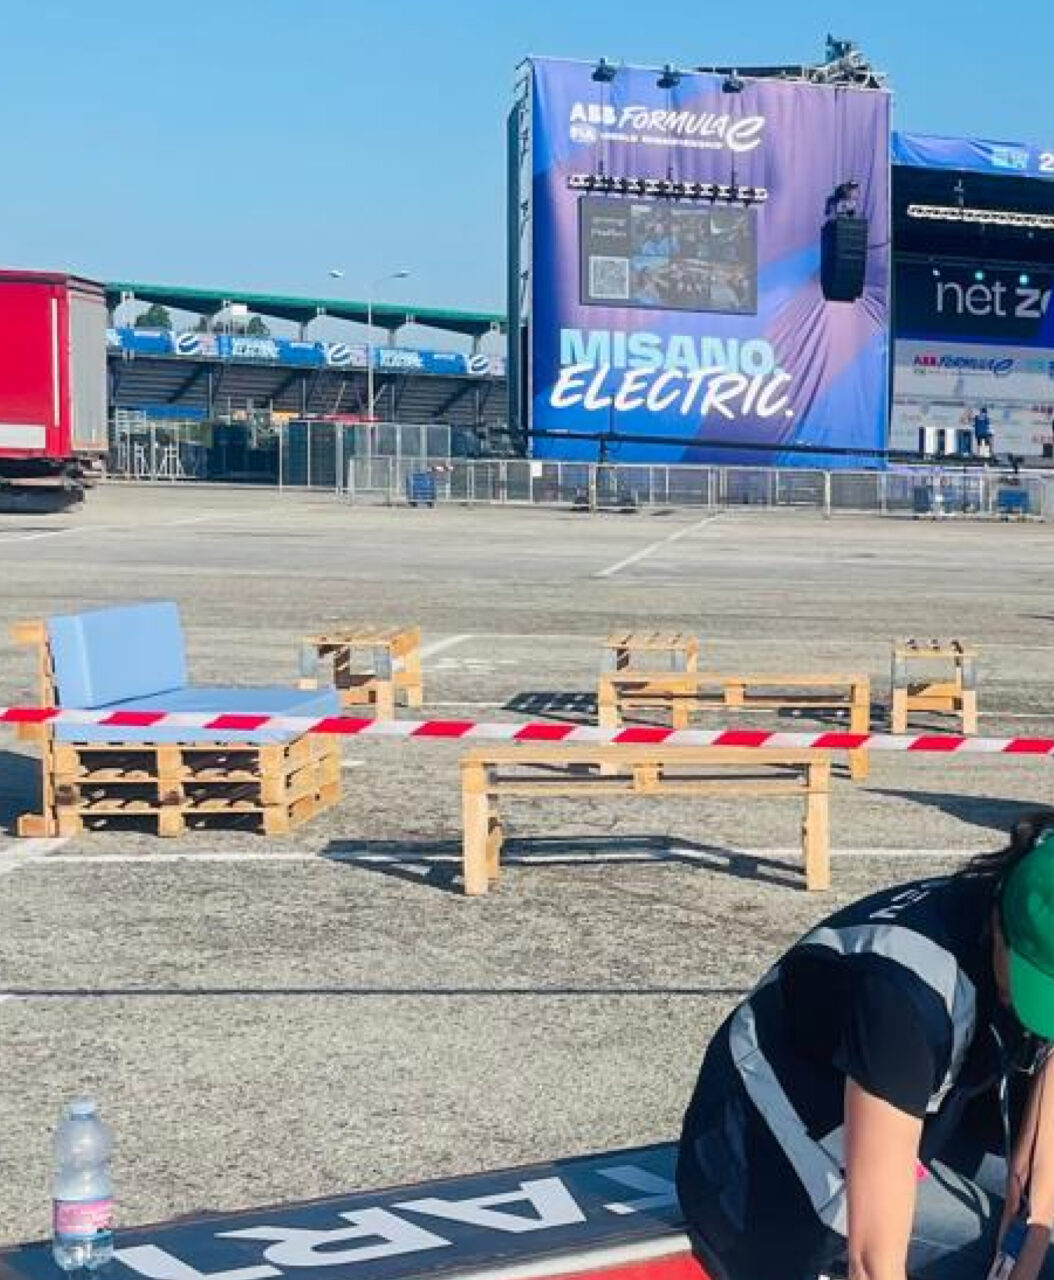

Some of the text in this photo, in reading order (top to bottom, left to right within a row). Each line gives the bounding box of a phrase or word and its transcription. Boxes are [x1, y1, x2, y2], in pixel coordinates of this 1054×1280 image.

[570, 101, 616, 124] ABB
[936, 280, 1007, 317] net
[550, 362, 794, 419] ELECTRIC.
